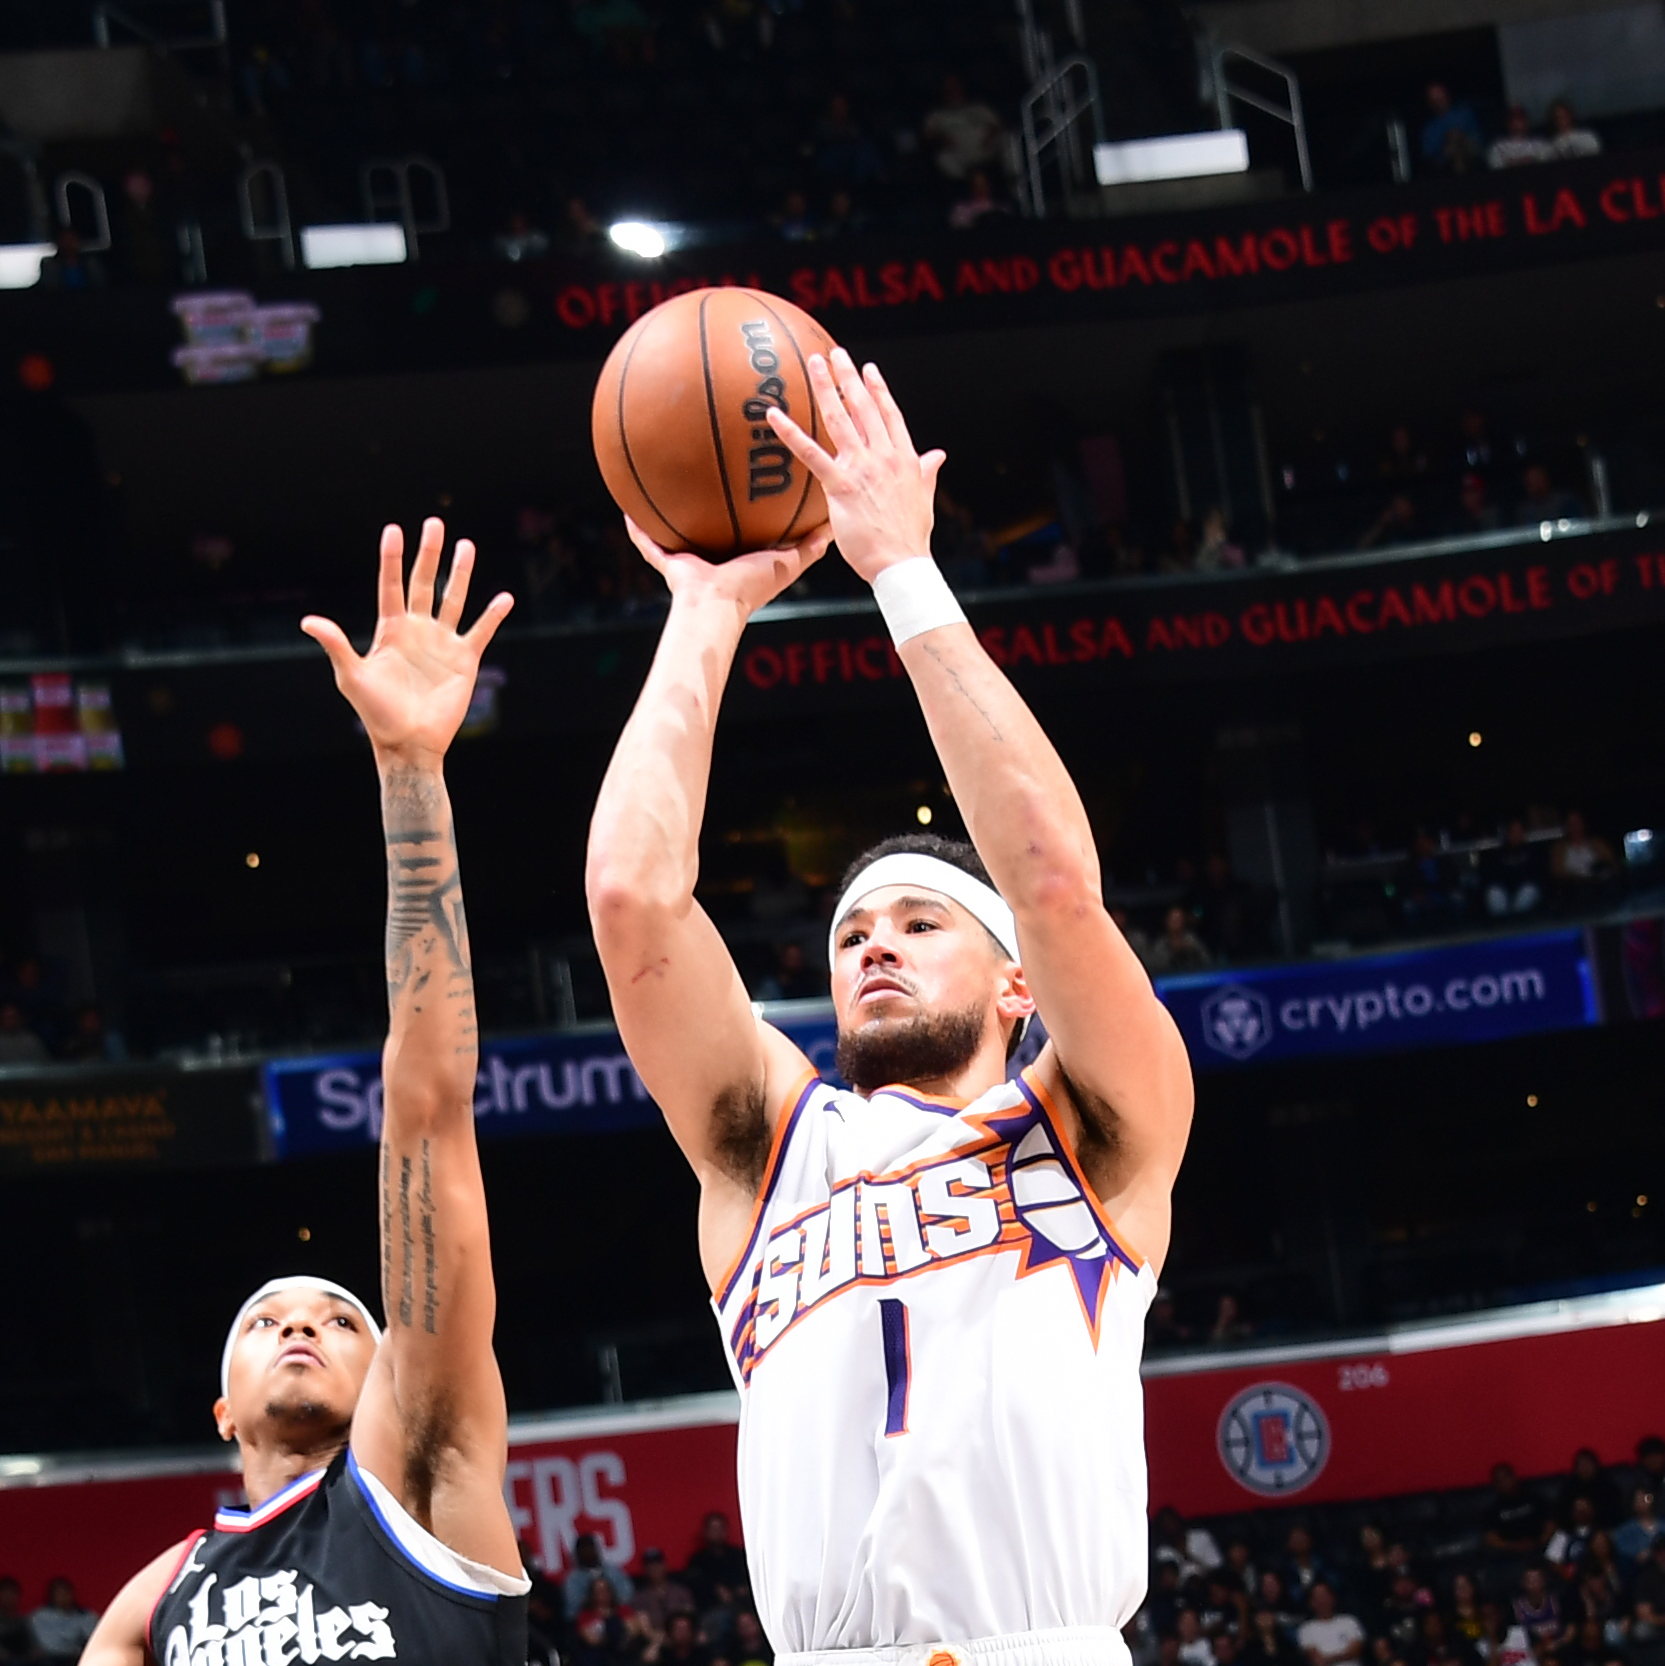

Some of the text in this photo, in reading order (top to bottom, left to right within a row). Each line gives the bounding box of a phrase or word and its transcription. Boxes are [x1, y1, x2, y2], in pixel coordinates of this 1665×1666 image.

[788, 258, 945, 309] SALSA
[953, 254, 1041, 296] AND
[1047, 218, 1352, 294] GUACAMOLE
[1366, 214, 1420, 255] OF
[1434, 200, 1506, 246] THE
[1522, 186, 1587, 237] LA
[741, 320, 794, 501] Wilson
[980, 617, 1135, 668] SALSA
[1144, 611, 1231, 652] AND
[1239, 566, 1552, 648] GUACAMOLE
[1566, 558, 1618, 600] OF
[1279, 965, 1547, 1033] crypto.com
[877, 1297, 913, 1439] 1
[1337, 1361, 1391, 1394] 206
[188, 1568, 300, 1652] Los
